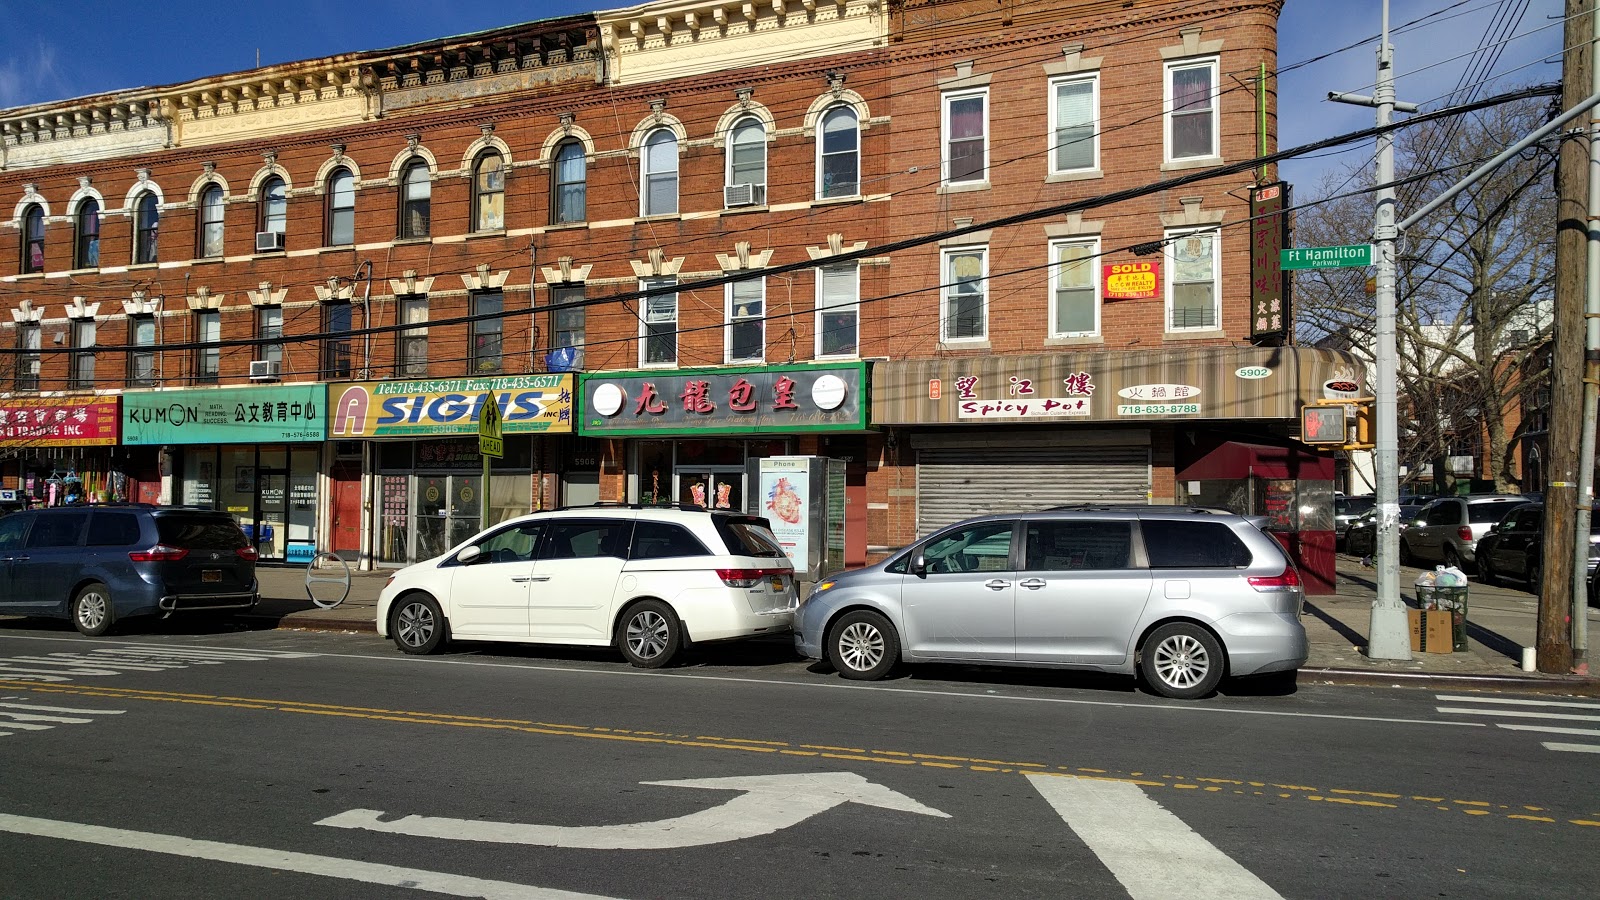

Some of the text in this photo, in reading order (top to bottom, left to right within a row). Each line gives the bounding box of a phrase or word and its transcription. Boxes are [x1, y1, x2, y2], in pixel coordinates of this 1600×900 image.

[1289, 247, 1365, 261] Ft Hamilton
[1112, 263, 1152, 273] SOLD
[1272, 261, 1281, 292] POT
[1256, 301, 1268, 331] 火鍋
[1240, 369, 1268, 377] 5902
[956, 372, 1094, 398] 望江樓
[1129, 386, 1189, 398] 火鍋館
[633, 375, 800, 413] 九龍包皇
[234, 401, 316, 423] 公文教育中心
[333, 385, 369, 435] A
[376, 391, 543, 424] SIGNS
[962, 399, 1086, 415] Spicy Pot
[1121, 404, 1197, 414] 718-633-8788
[130, 403, 198, 427] KUMON
[64, 424, 83, 435] INC.
[432, 425, 458, 433] 5906
[483, 439, 500, 453] AHEAD
[574, 458, 595, 466] 5906
[262, 488, 284, 496] KUMON
